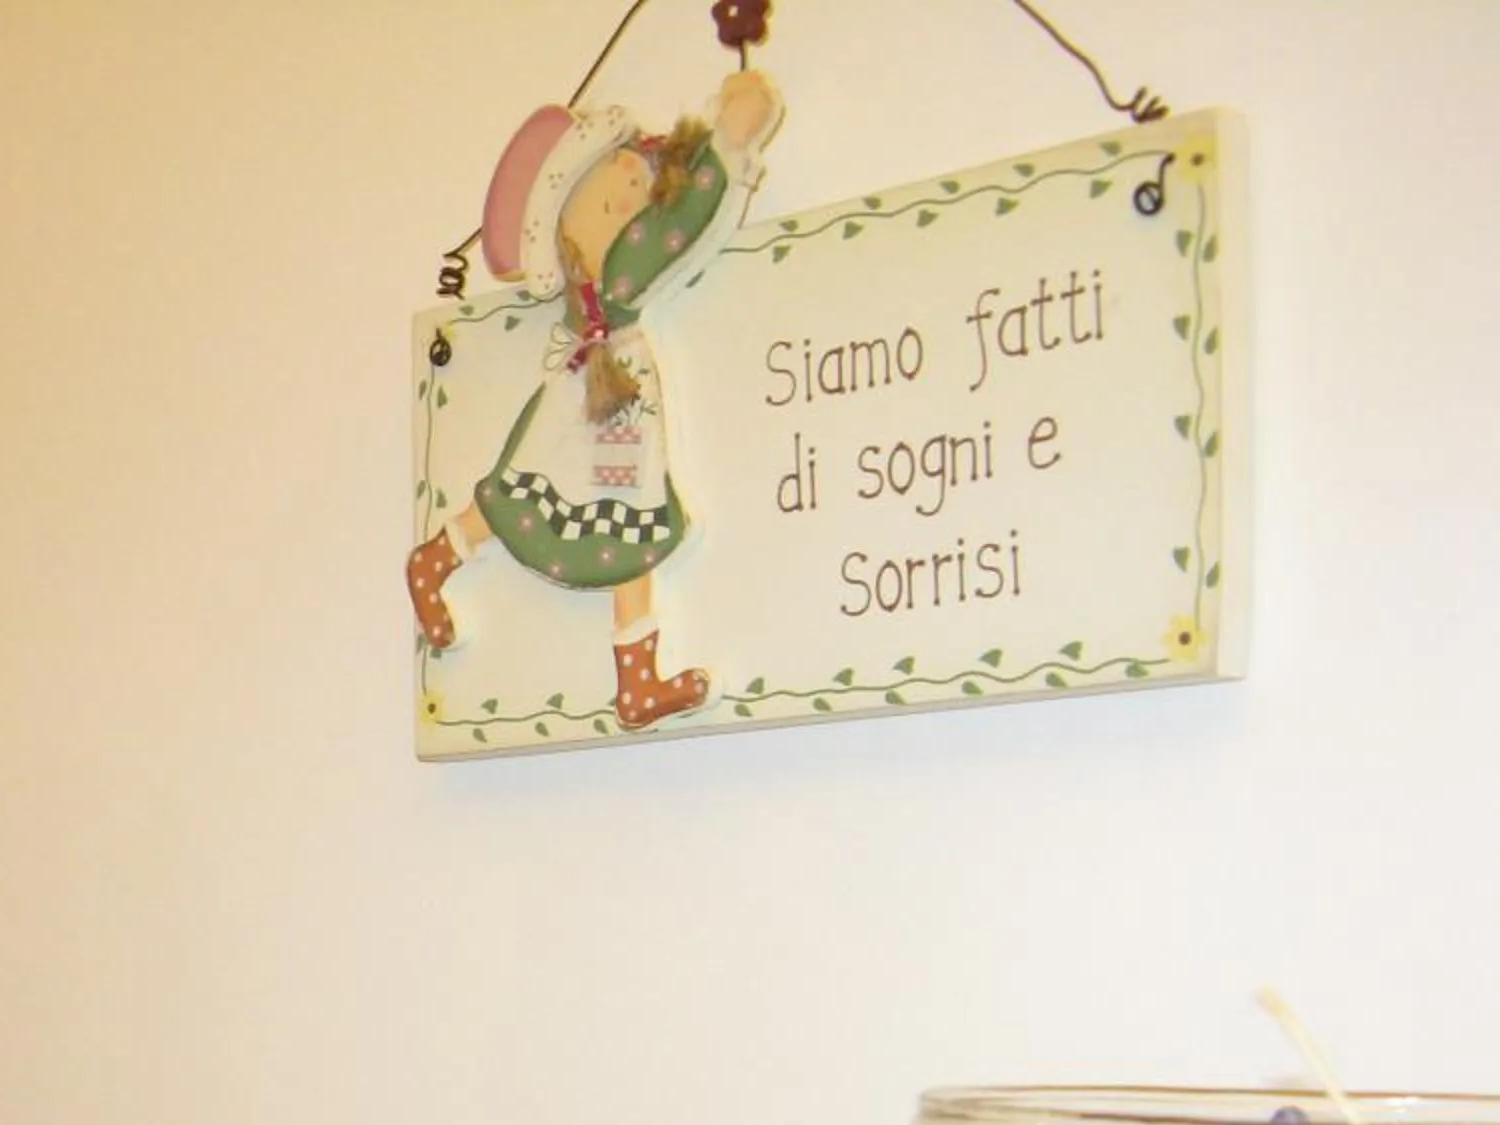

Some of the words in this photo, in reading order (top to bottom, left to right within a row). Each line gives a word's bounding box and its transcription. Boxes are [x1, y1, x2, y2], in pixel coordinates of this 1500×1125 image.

[765, 326, 924, 407] Siamo
[965, 268, 1105, 393] fatti
[776, 432, 818, 513] di
[857, 420, 994, 517] sogni
[1027, 416, 1062, 470] e
